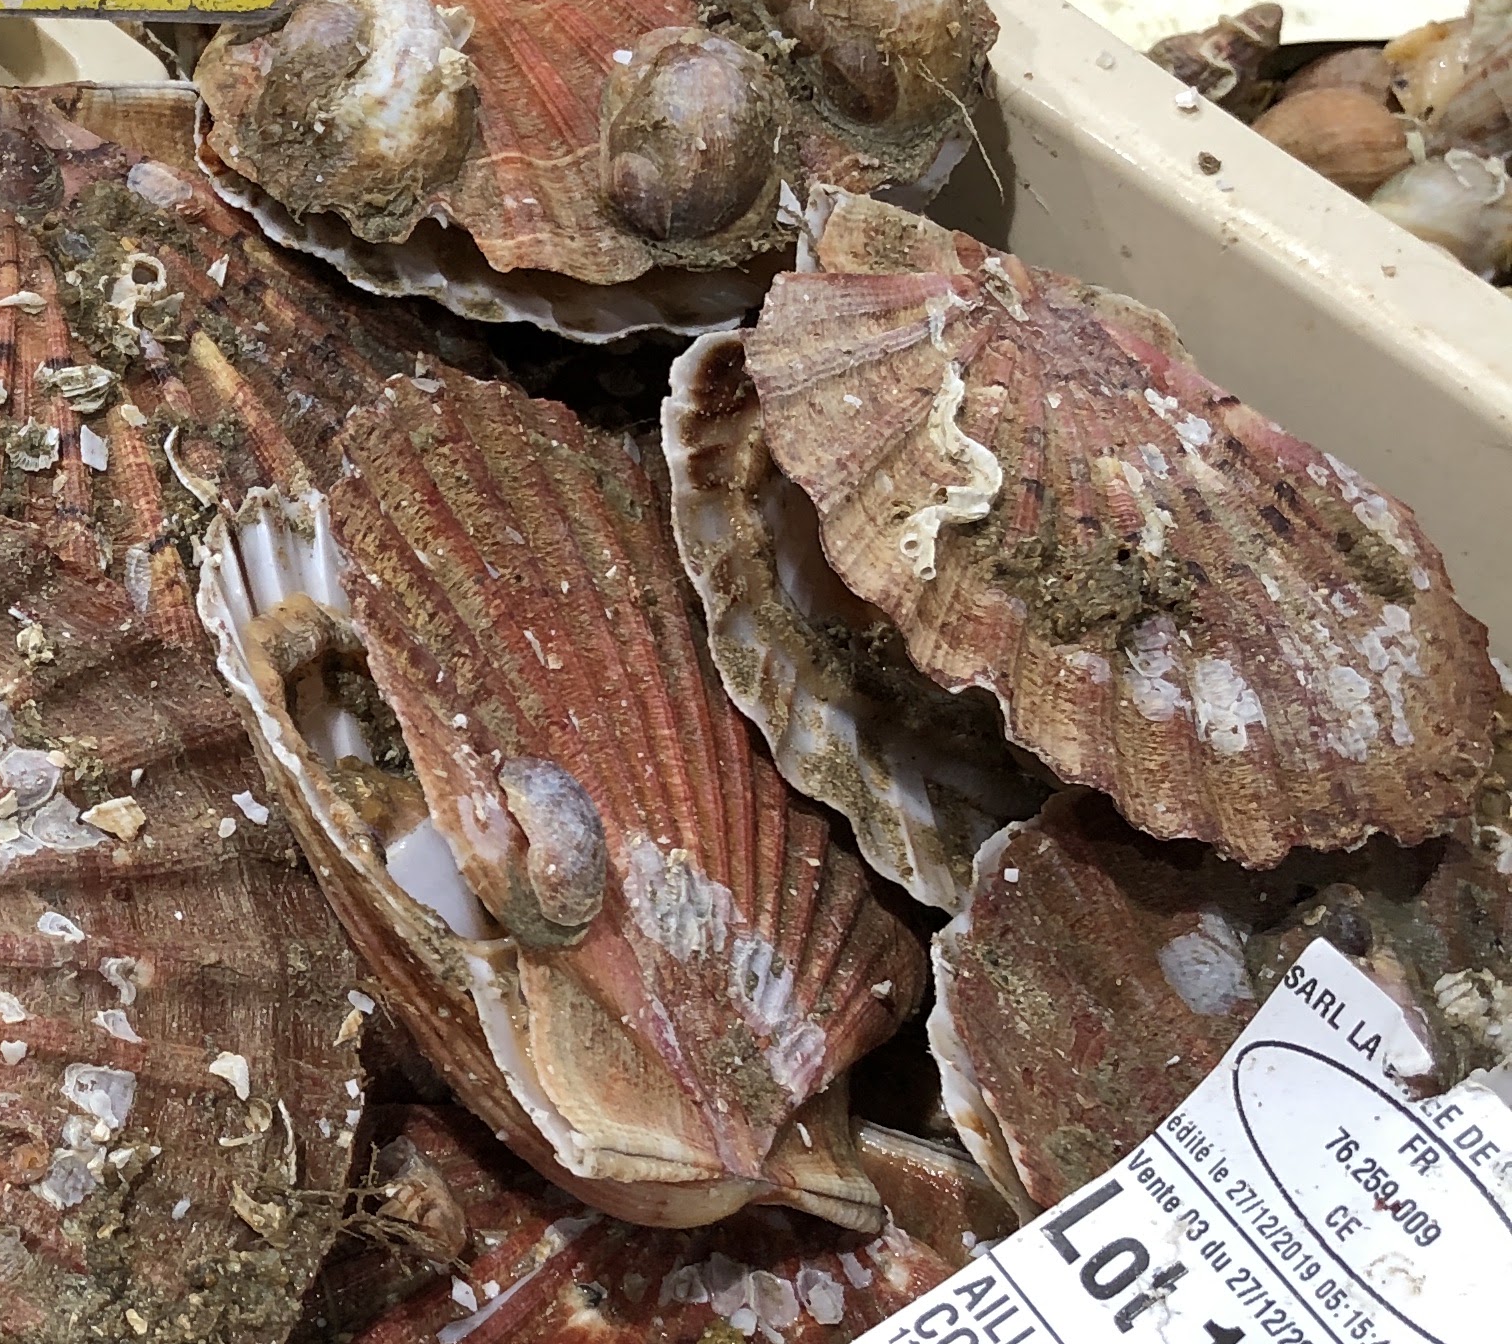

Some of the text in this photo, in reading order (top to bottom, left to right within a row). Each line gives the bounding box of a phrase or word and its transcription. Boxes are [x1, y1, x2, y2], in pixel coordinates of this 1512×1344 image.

[1283, 964, 1346, 1031] SARL
[1346, 1020, 1383, 1062] LA
[1167, 1114, 1213, 1163] édité
[1209, 1158, 1228, 1182] le
[1226, 1180, 1320, 1281] 27/12/2019
[1397, 1132, 1440, 1176] FR
[1044, 1180, 1185, 1332] Lot
[1129, 1149, 1180, 1212] Vente
[1201, 1241, 1231, 1272] du
[1325, 1204, 1363, 1243] CE
